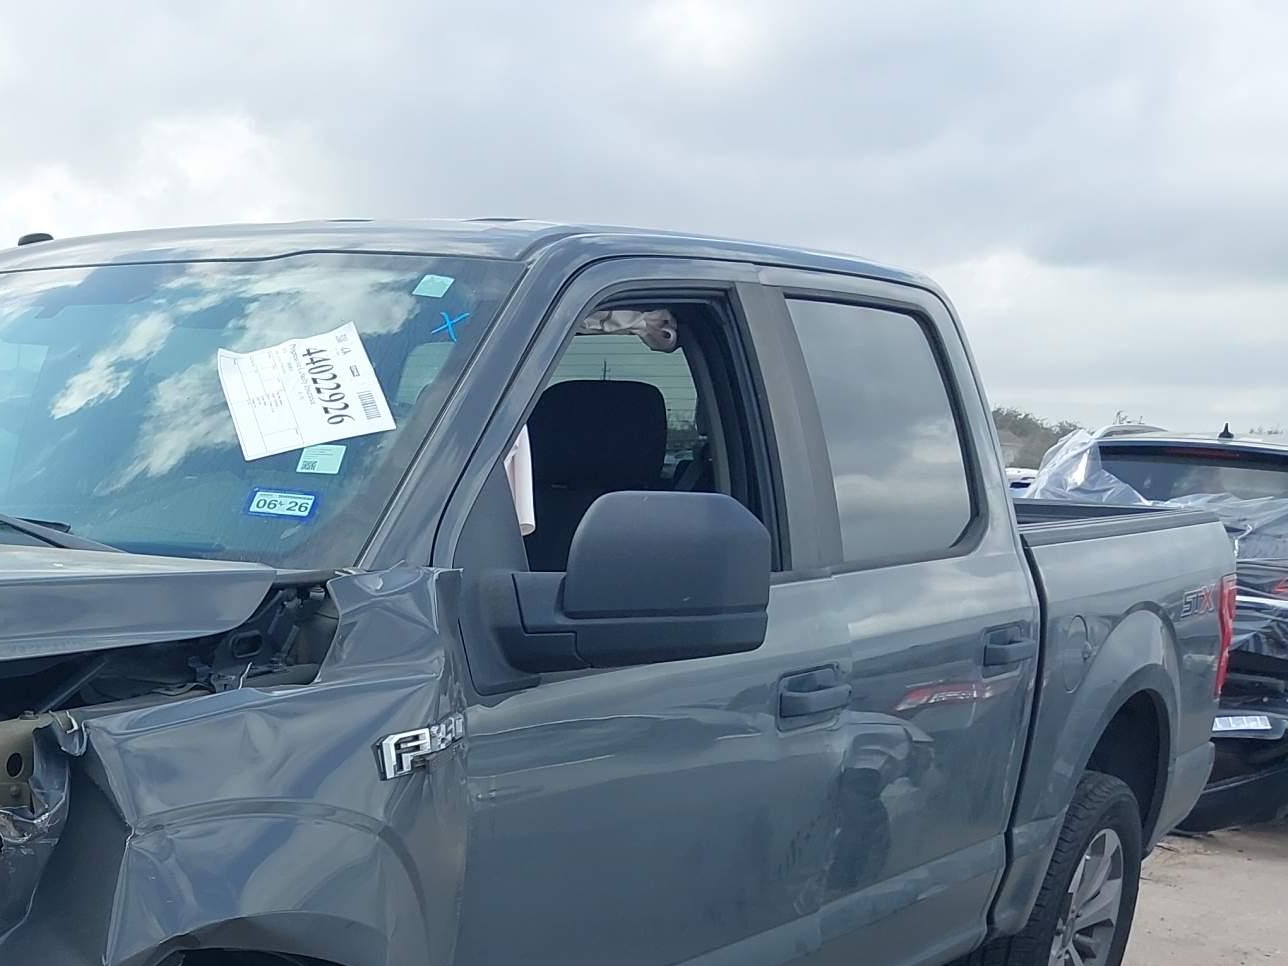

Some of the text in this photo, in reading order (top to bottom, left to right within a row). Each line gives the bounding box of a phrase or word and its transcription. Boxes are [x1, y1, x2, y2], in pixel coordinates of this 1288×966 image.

[302, 348, 355, 425] 44022926
[256, 498, 310, 513] 06 26
